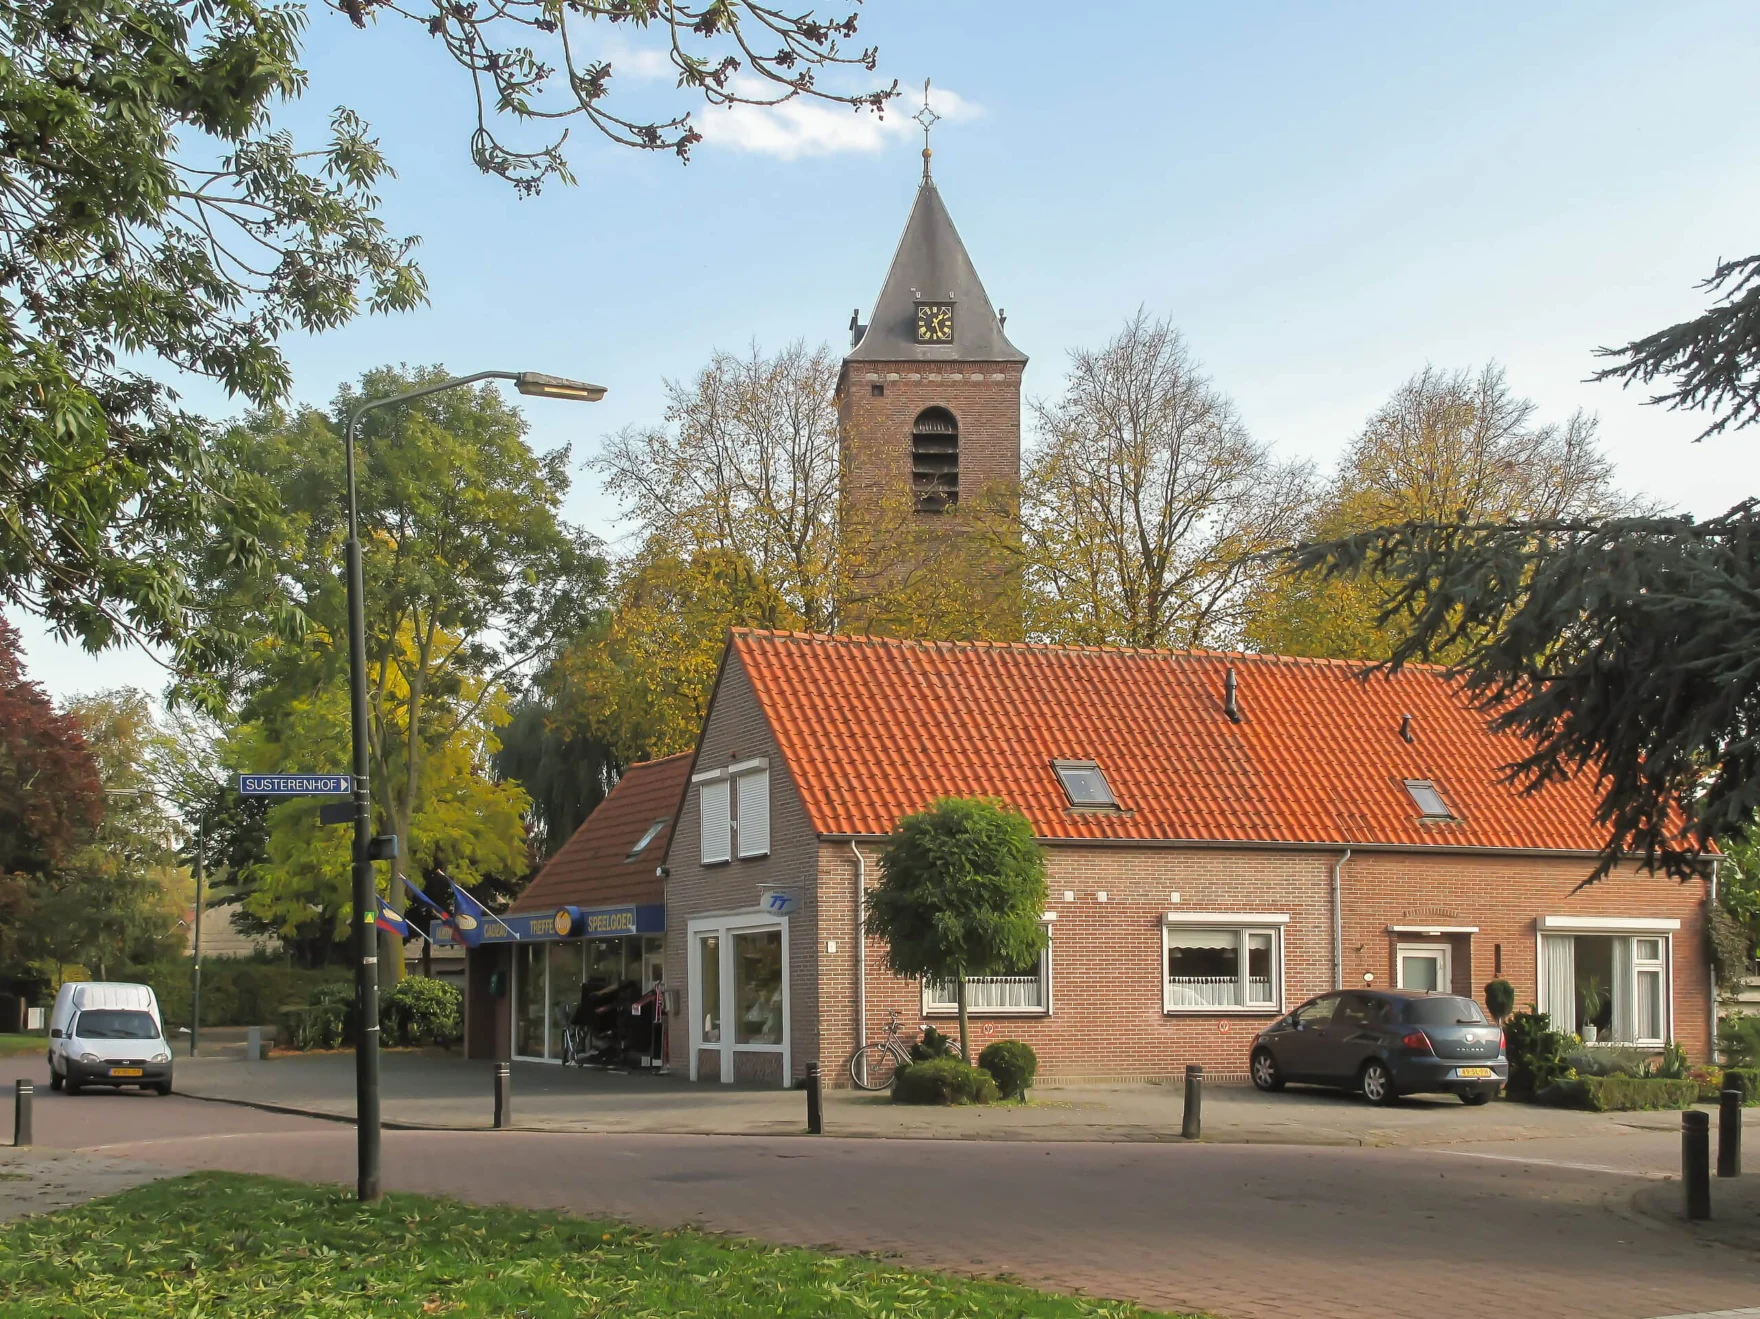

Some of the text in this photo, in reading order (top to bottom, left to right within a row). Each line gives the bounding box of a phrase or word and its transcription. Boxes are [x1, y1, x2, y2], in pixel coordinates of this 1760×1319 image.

[246, 779, 337, 791] SUSTERENHOF
[769, 895, 792, 911] TT
[588, 912, 632, 932] SPEELGOED
